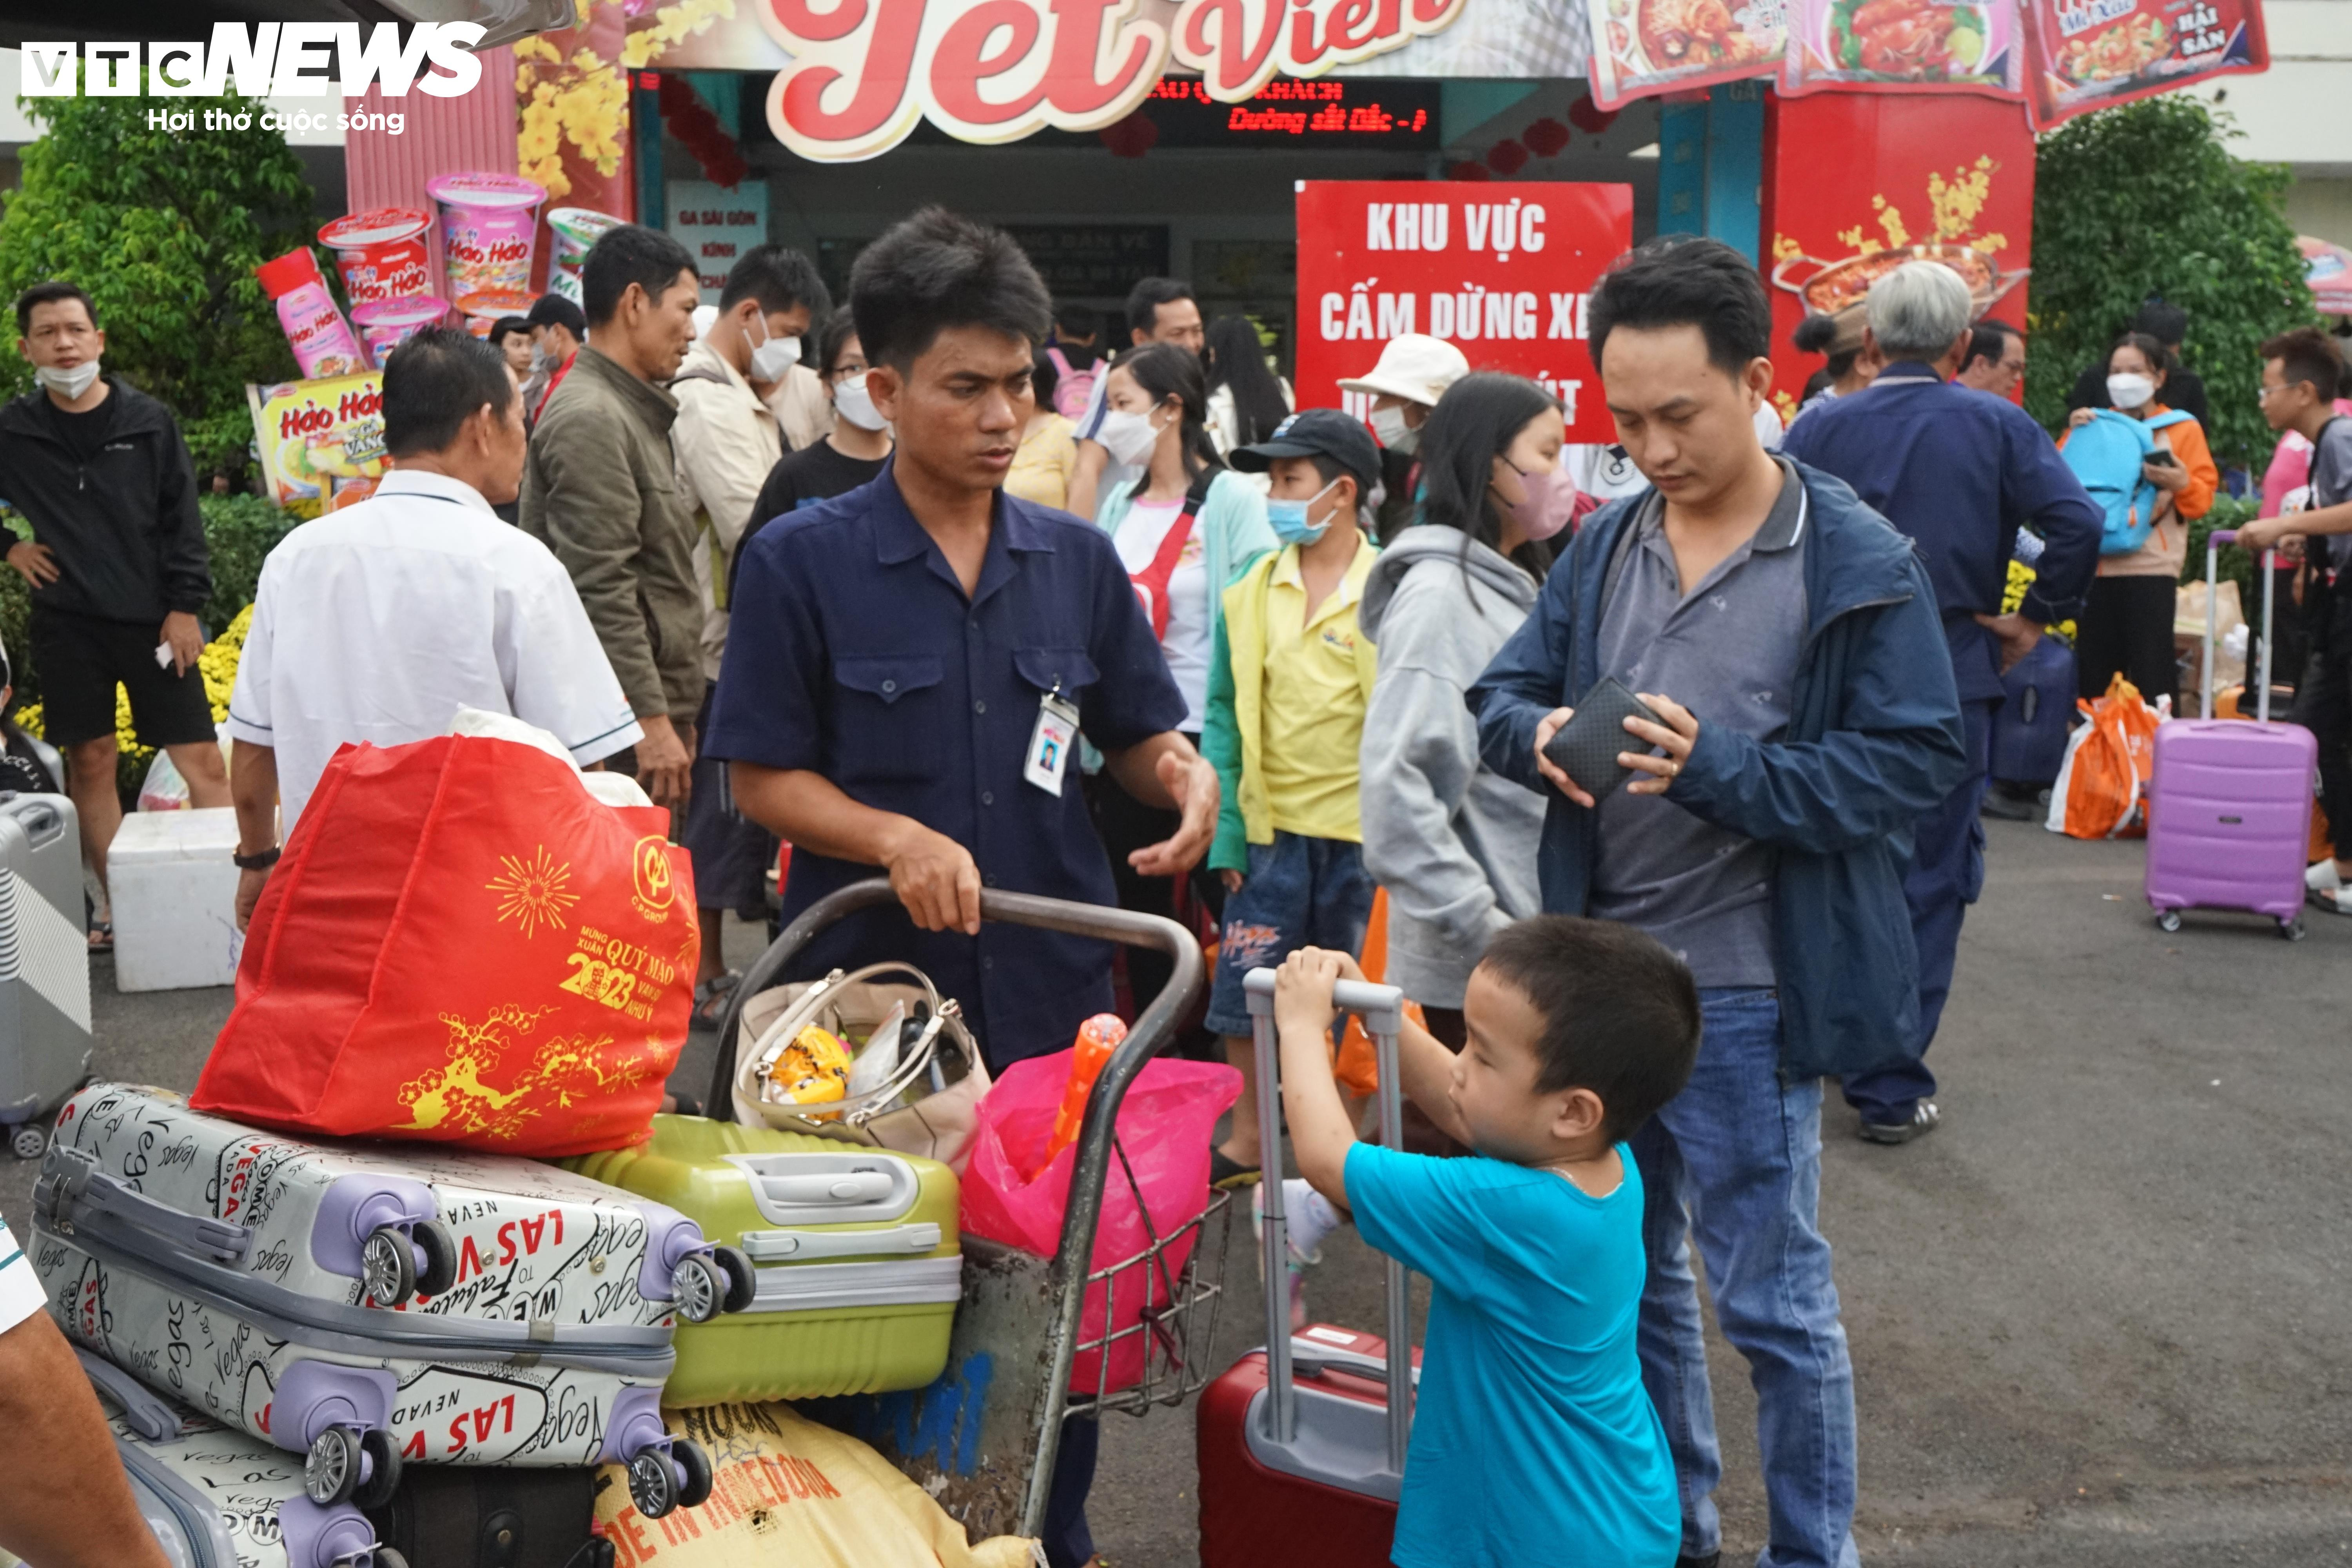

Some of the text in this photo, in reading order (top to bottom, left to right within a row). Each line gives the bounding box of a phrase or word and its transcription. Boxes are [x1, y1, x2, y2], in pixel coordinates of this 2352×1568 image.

[1367, 198, 1546, 262] KHU VỰC
[1320, 278, 1415, 341] CẤM
[1431, 281, 1538, 340] DỪNG
[280, 399, 334, 439] Hảo
[559, 952, 636, 1010] 2023
[158, 1135, 200, 1173] Vegas
[223, 1143, 275, 1222] VEGA
[447, 1200, 498, 1226] NEVA
[496, 1208, 564, 1267] LAS
[36, 1240, 68, 1277] Vegas
[251, 1239, 294, 1283] Vegas
[519, 1265, 534, 1284] TO
[84, 1279, 97, 1336] GAS
[168, 1299, 191, 1389] egas
[214, 1321, 250, 1385] Vegas
[392, 1388, 460, 1425] NEVAD
[447, 1394, 515, 1454] LAS
